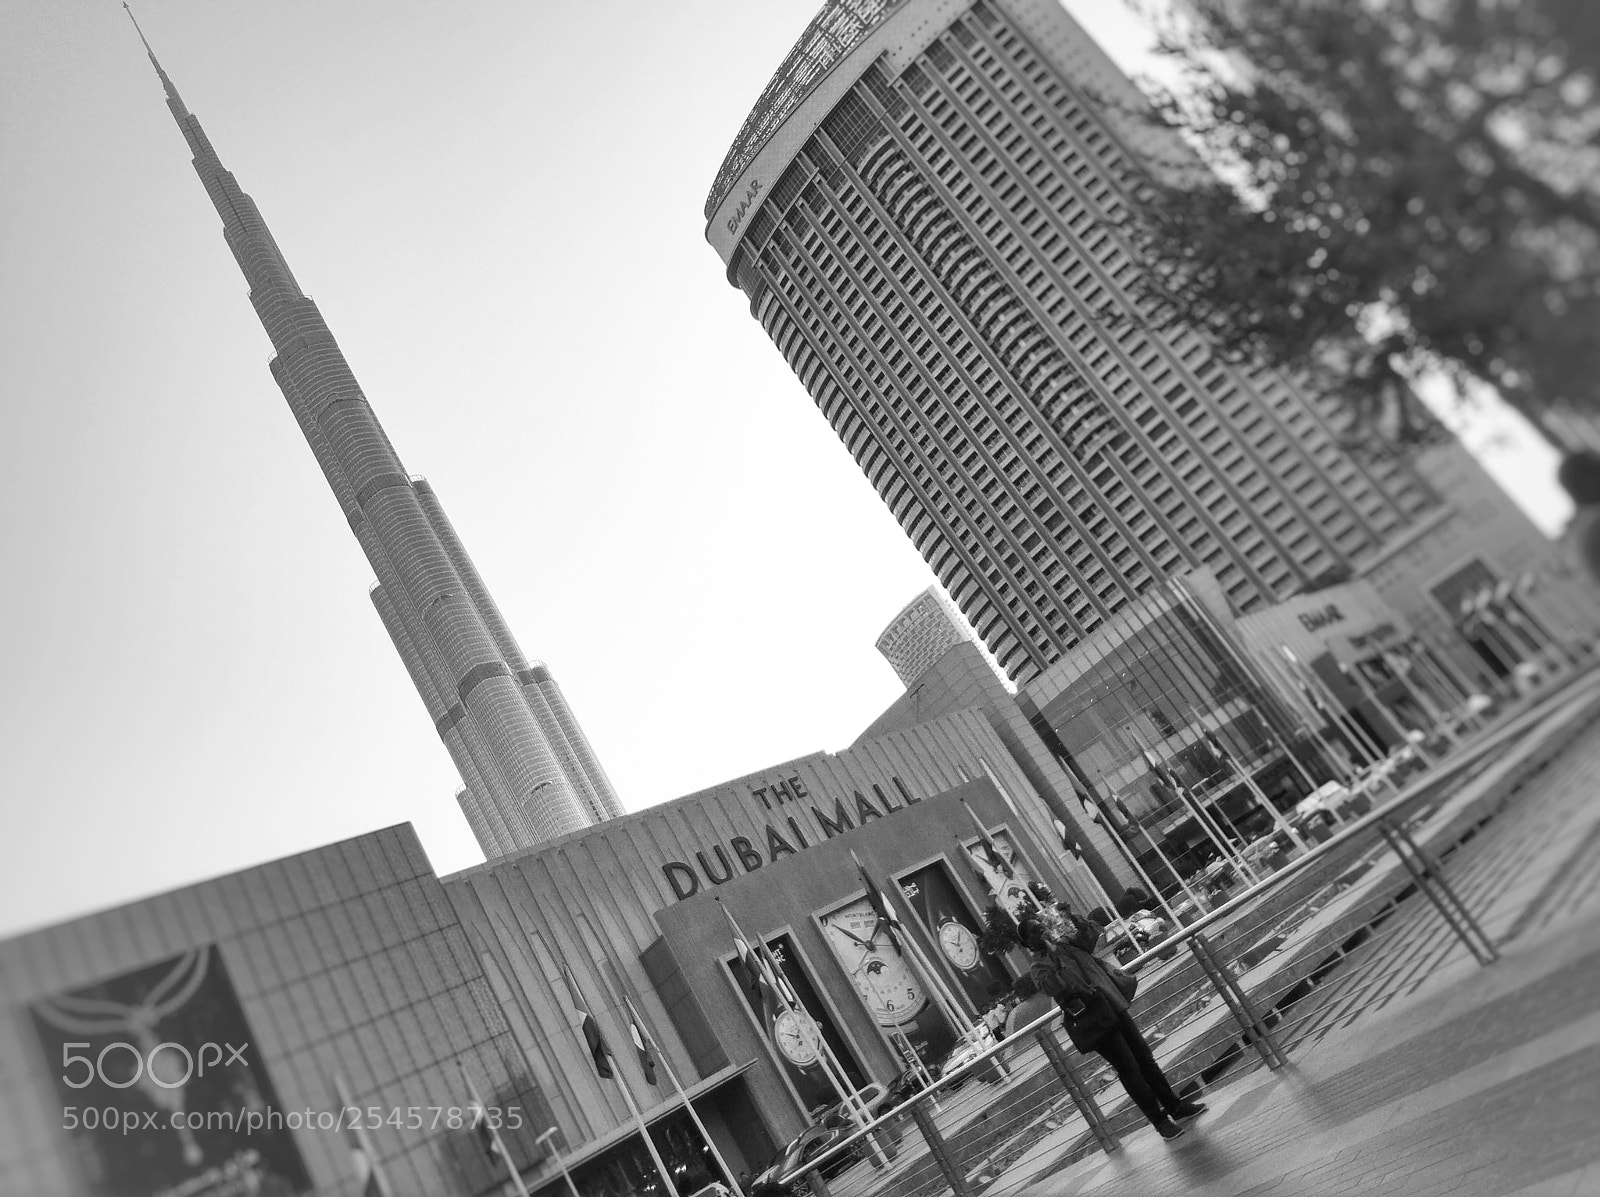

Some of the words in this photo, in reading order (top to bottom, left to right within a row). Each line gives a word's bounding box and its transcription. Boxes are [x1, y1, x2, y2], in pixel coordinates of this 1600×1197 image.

[727, 179, 763, 236] EMAAR
[752, 776, 808, 810] THE
[661, 816, 810, 901] DUBAI
[811, 776, 922, 839] MALL
[886, 999, 895, 1012] 6
[906, 988, 915, 1000] 5
